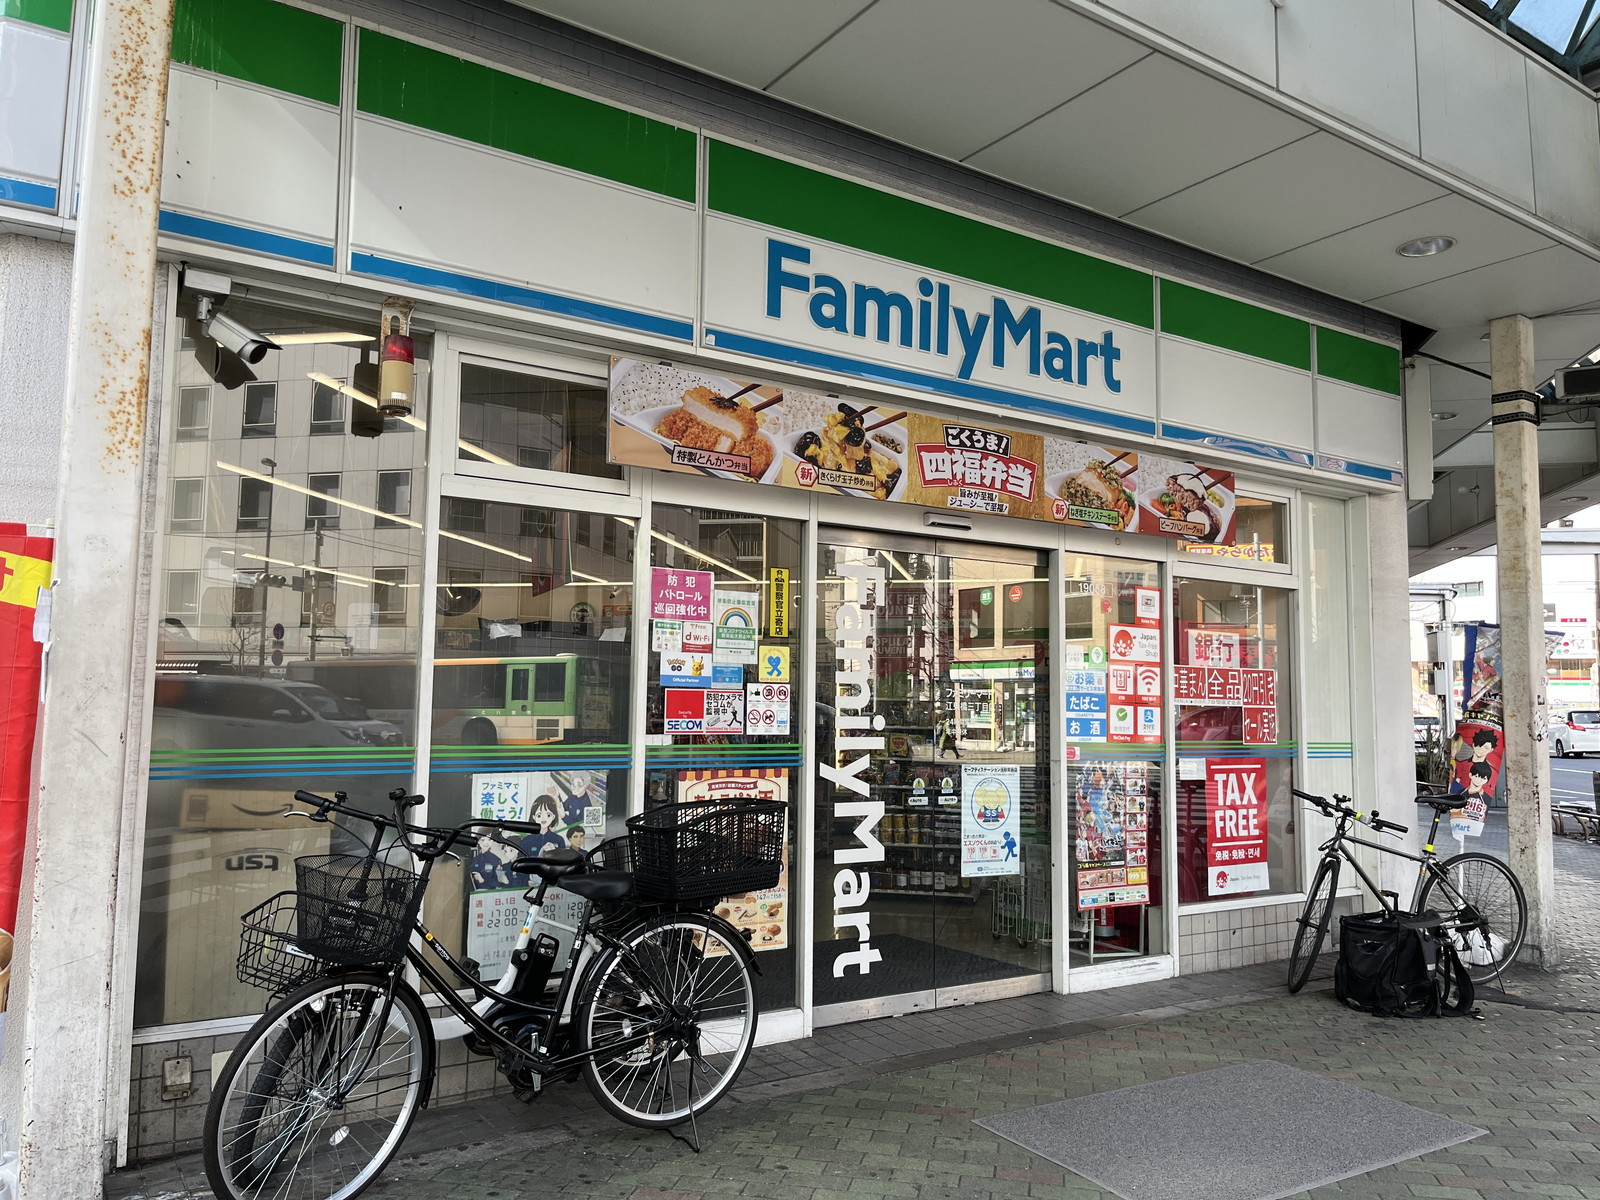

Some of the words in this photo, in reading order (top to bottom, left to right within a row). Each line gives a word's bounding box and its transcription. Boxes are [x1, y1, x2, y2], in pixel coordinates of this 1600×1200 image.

[765, 238, 1122, 394] FamilyMart
[676, 449, 750, 473] 特製とんかつ弁当
[799, 466, 814, 482] 新
[819, 470, 874, 488] きくらげ玉子炒め弁当
[919, 448, 1033, 499] 四福弁当
[949, 497, 1008, 513] ジューシーで至福!
[1055, 503, 1065, 516] 新
[667, 575, 696, 588] 防犯
[659, 588, 703, 601] パトロール
[654, 602, 708, 617] 巡回強化中
[1208, 669, 1241, 699] 全品
[1069, 695, 1100, 711] たばこ
[667, 720, 703, 731] SECOM
[1069, 720, 1101, 735] お酒
[819, 564, 886, 979] FamilyMart
[481, 781, 520, 790] ファミマで
[1214, 772, 1258, 806] TAX
[480, 792, 519, 806] 楽しく
[480, 807, 524, 820] 働こう!
[985, 809, 997, 817] SS
[1214, 808, 1260, 838] FREE
